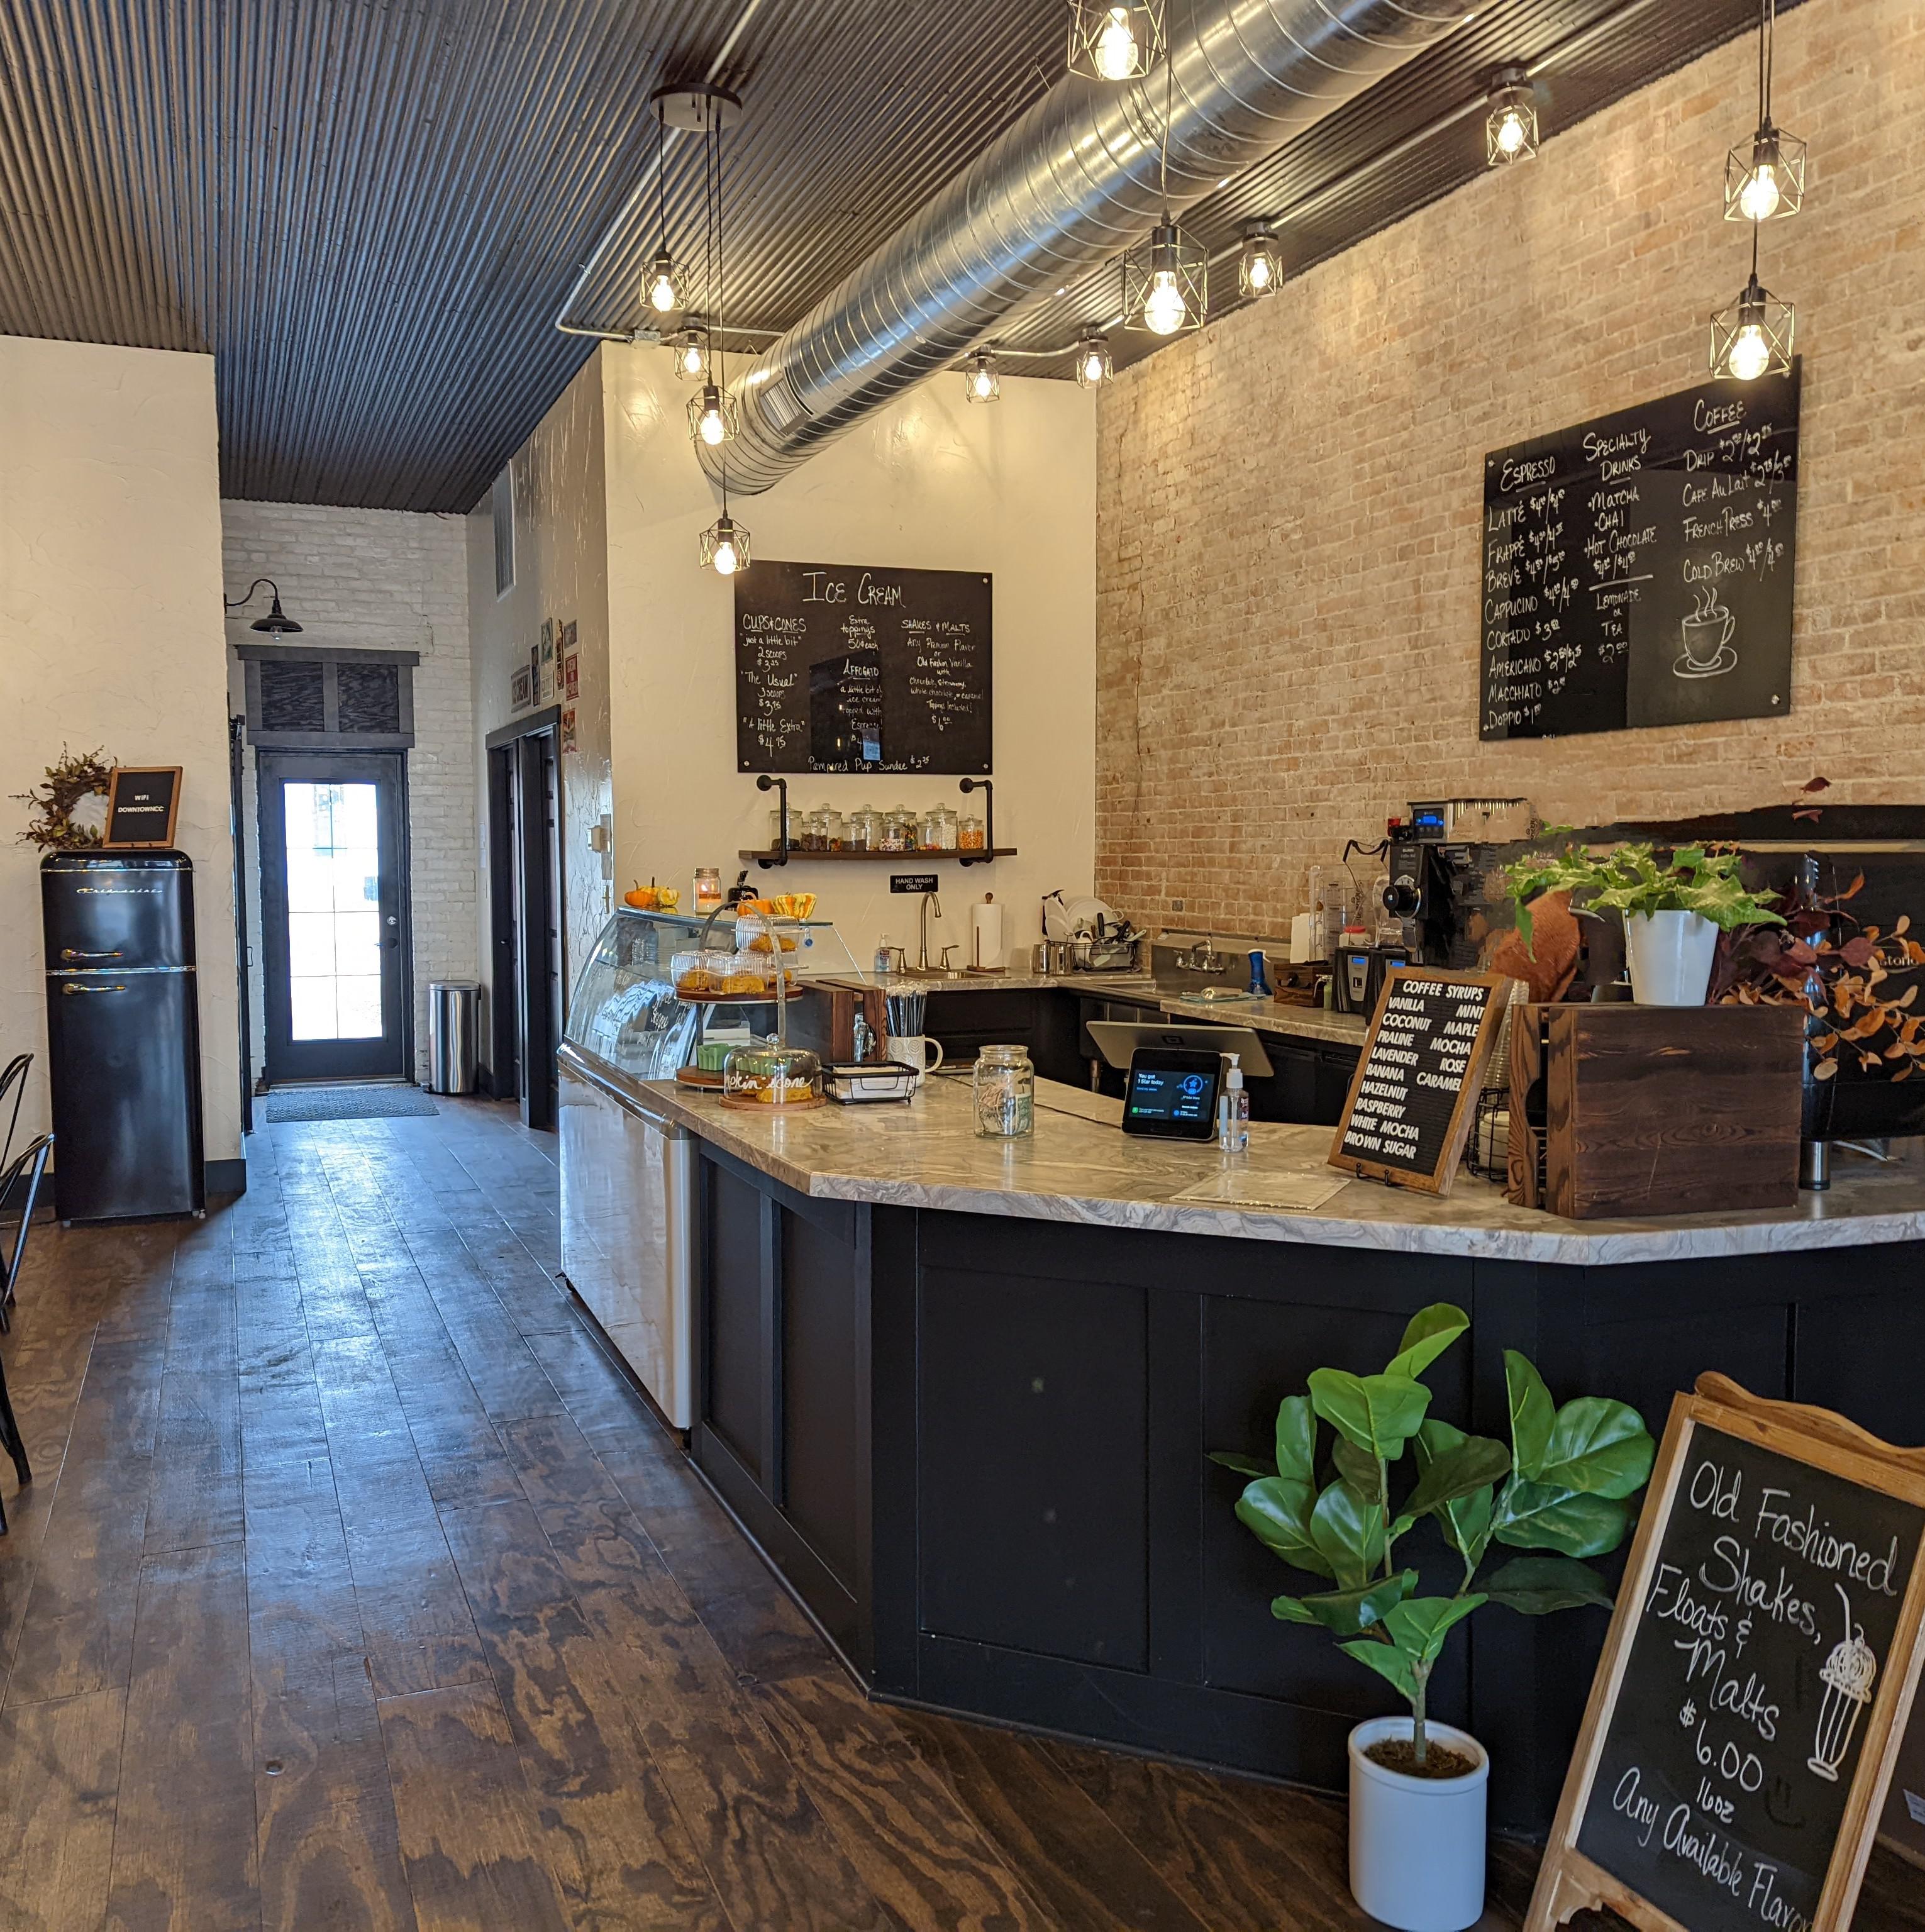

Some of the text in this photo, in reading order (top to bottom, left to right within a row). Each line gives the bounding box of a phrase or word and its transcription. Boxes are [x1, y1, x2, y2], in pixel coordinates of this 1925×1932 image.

[1694, 399, 1747, 431] COFFEE
[1583, 428, 1651, 462] SPECIALTY
[1599, 454, 1641, 481] DRINKS
[1683, 449, 1714, 472] DRIP
[1500, 456, 1556, 492] ESPRESSO
[1712, 477, 1728, 499] Au
[1728, 470, 1750, 496] Lait
[1598, 509, 1624, 531] CHAI
[1683, 516, 1723, 542] FRENCH
[1721, 506, 1754, 536] PRESS
[1587, 526, 1657, 558] HOT CHOCOLATE
[1684, 559, 1712, 582] COLD
[1711, 552, 1745, 577] BREW
[802, 571, 906, 608] ICE CREAM
[1596, 589, 1641, 610] LEMONADE
[1485, 596, 1538, 624] CAPPUCINO
[840, 623, 875, 640] toppings
[901, 619, 931, 631] SHAKES
[941, 621, 970, 633] MALTS
[1601, 620, 1623, 636] TEA
[766, 635, 784, 645] little
[906, 637, 921, 653] Any
[1487, 628, 1530, 650] CORTADO
[758, 647, 765, 658] 2
[917, 656, 928, 667] Old
[948, 657, 973, 667] Vanilla
[843, 658, 879, 677] AFFOGATO
[1489, 655, 1541, 679] AMERICANO
[757, 687, 766, 697] 3
[846, 694, 860, 702] ice
[848, 684, 864, 694] little
[865, 684, 875, 694] bit
[1488, 682, 1542, 703] MACCHIATO
[757, 718, 776, 732] little
[1489, 709, 1522, 730] DOPPIO
[808, 755, 848, 773] Pampered
[855, 757, 872, 772] Pup
[879, 760, 908, 772] Sundae
[1402, 980, 1484, 1001] COFFEE SYRUPS
[1388, 996, 1424, 1013] VANILLA
[1455, 1004, 1485, 1020] MINT
[1382, 1013, 1433, 1032] COCONUT
[1443, 1021, 1479, 1037] MAPLE
[1377, 1030, 1415, 1047] PRALINE
[1429, 1037, 1472, 1055] MOCHA
[1371, 1046, 1419, 1067] LAVENDER
[1439, 1058, 1467, 1074] ROSE
[1365, 1063, 1404, 1082] BANANA
[1416, 1072, 1462, 1092] CARAMEL
[1360, 1080, 1409, 1101] HAZELNUT
[1355, 1097, 1406, 1119] RASPBERRY
[1350, 1114, 1419, 1141] WHITE MOCHA
[1344, 1131, 1416, 1159] BROWN SUGAR
[1690, 1460, 1898, 1596] Old Fashioned
[1645, 1563, 1729, 1641] Floats
[1673, 1638, 1780, 1741] Malts
[1613, 1766, 1659, 1848] Any
[1663, 1803, 1742, 1897] Available
